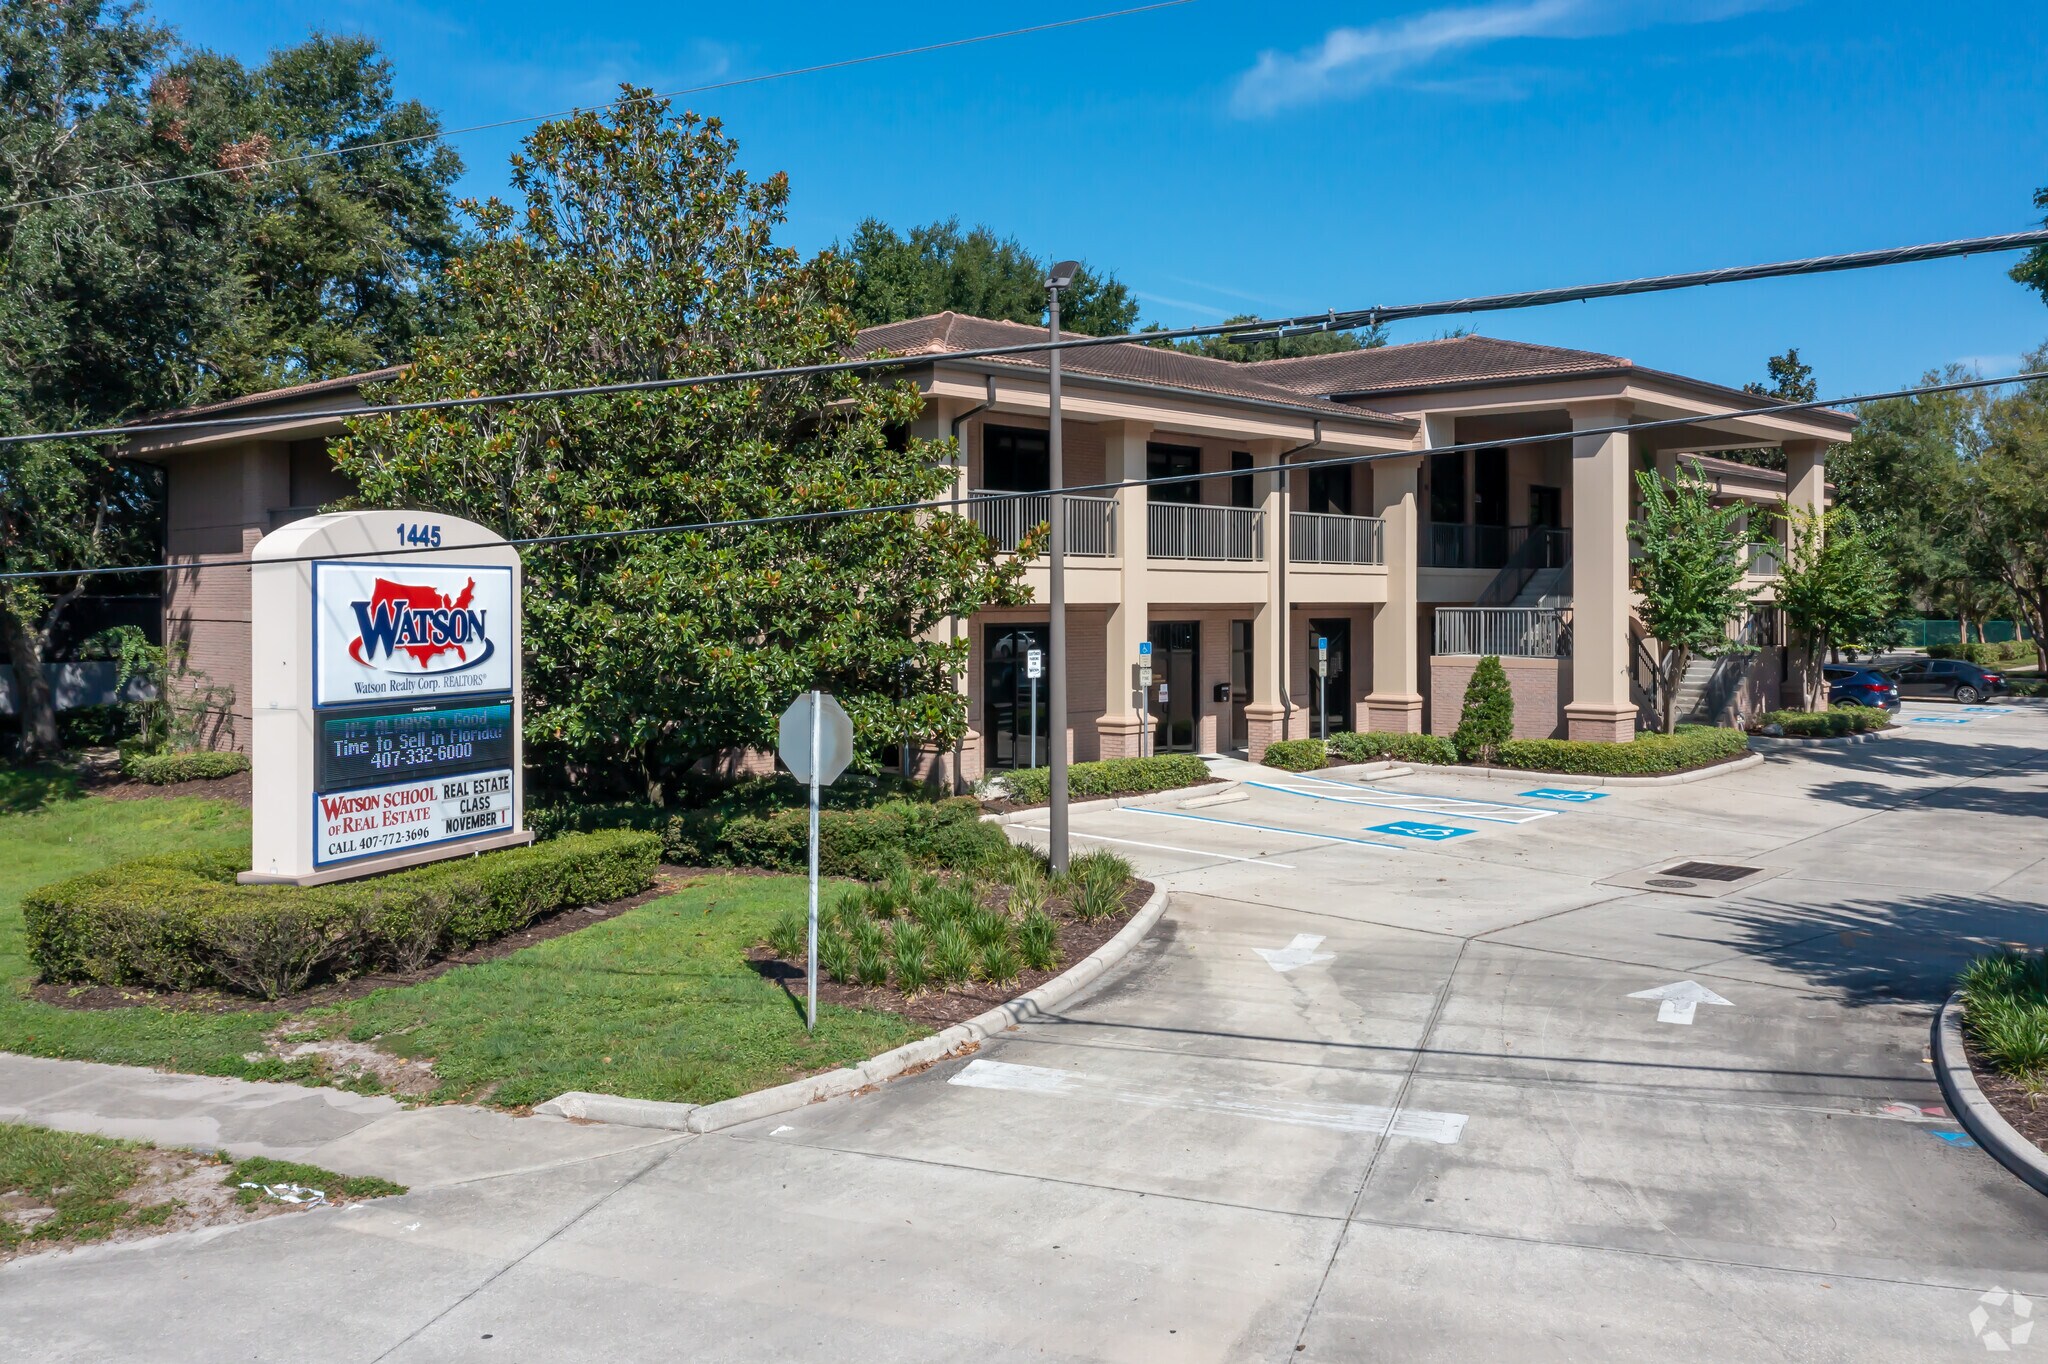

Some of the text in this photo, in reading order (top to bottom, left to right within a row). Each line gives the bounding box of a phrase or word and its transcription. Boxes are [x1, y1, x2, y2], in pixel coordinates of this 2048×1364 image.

[397, 523, 441, 547] 1445
[350, 599, 487, 661] WATSON
[354, 682, 387, 694] Watson
[390, 677, 416, 694] Realty
[418, 677, 440, 692] Corp.
[438, 717, 447, 729] a
[453, 710, 487, 728] Good
[334, 740, 369, 757] Time
[377, 736, 393, 752] to
[400, 731, 425, 749] Sell
[431, 730, 444, 746] in
[370, 742, 472, 769] 407-332-6000
[443, 775, 509, 800] REAL ESTATE
[321, 786, 438, 822] WATSON SCHOOL
[460, 795, 491, 814] CLASS
[342, 815, 378, 834] REAL
[382, 806, 431, 827] ESTATE
[446, 809, 505, 834] NOVEMBER 1
[328, 826, 430, 855] CALL 407-772-3696
